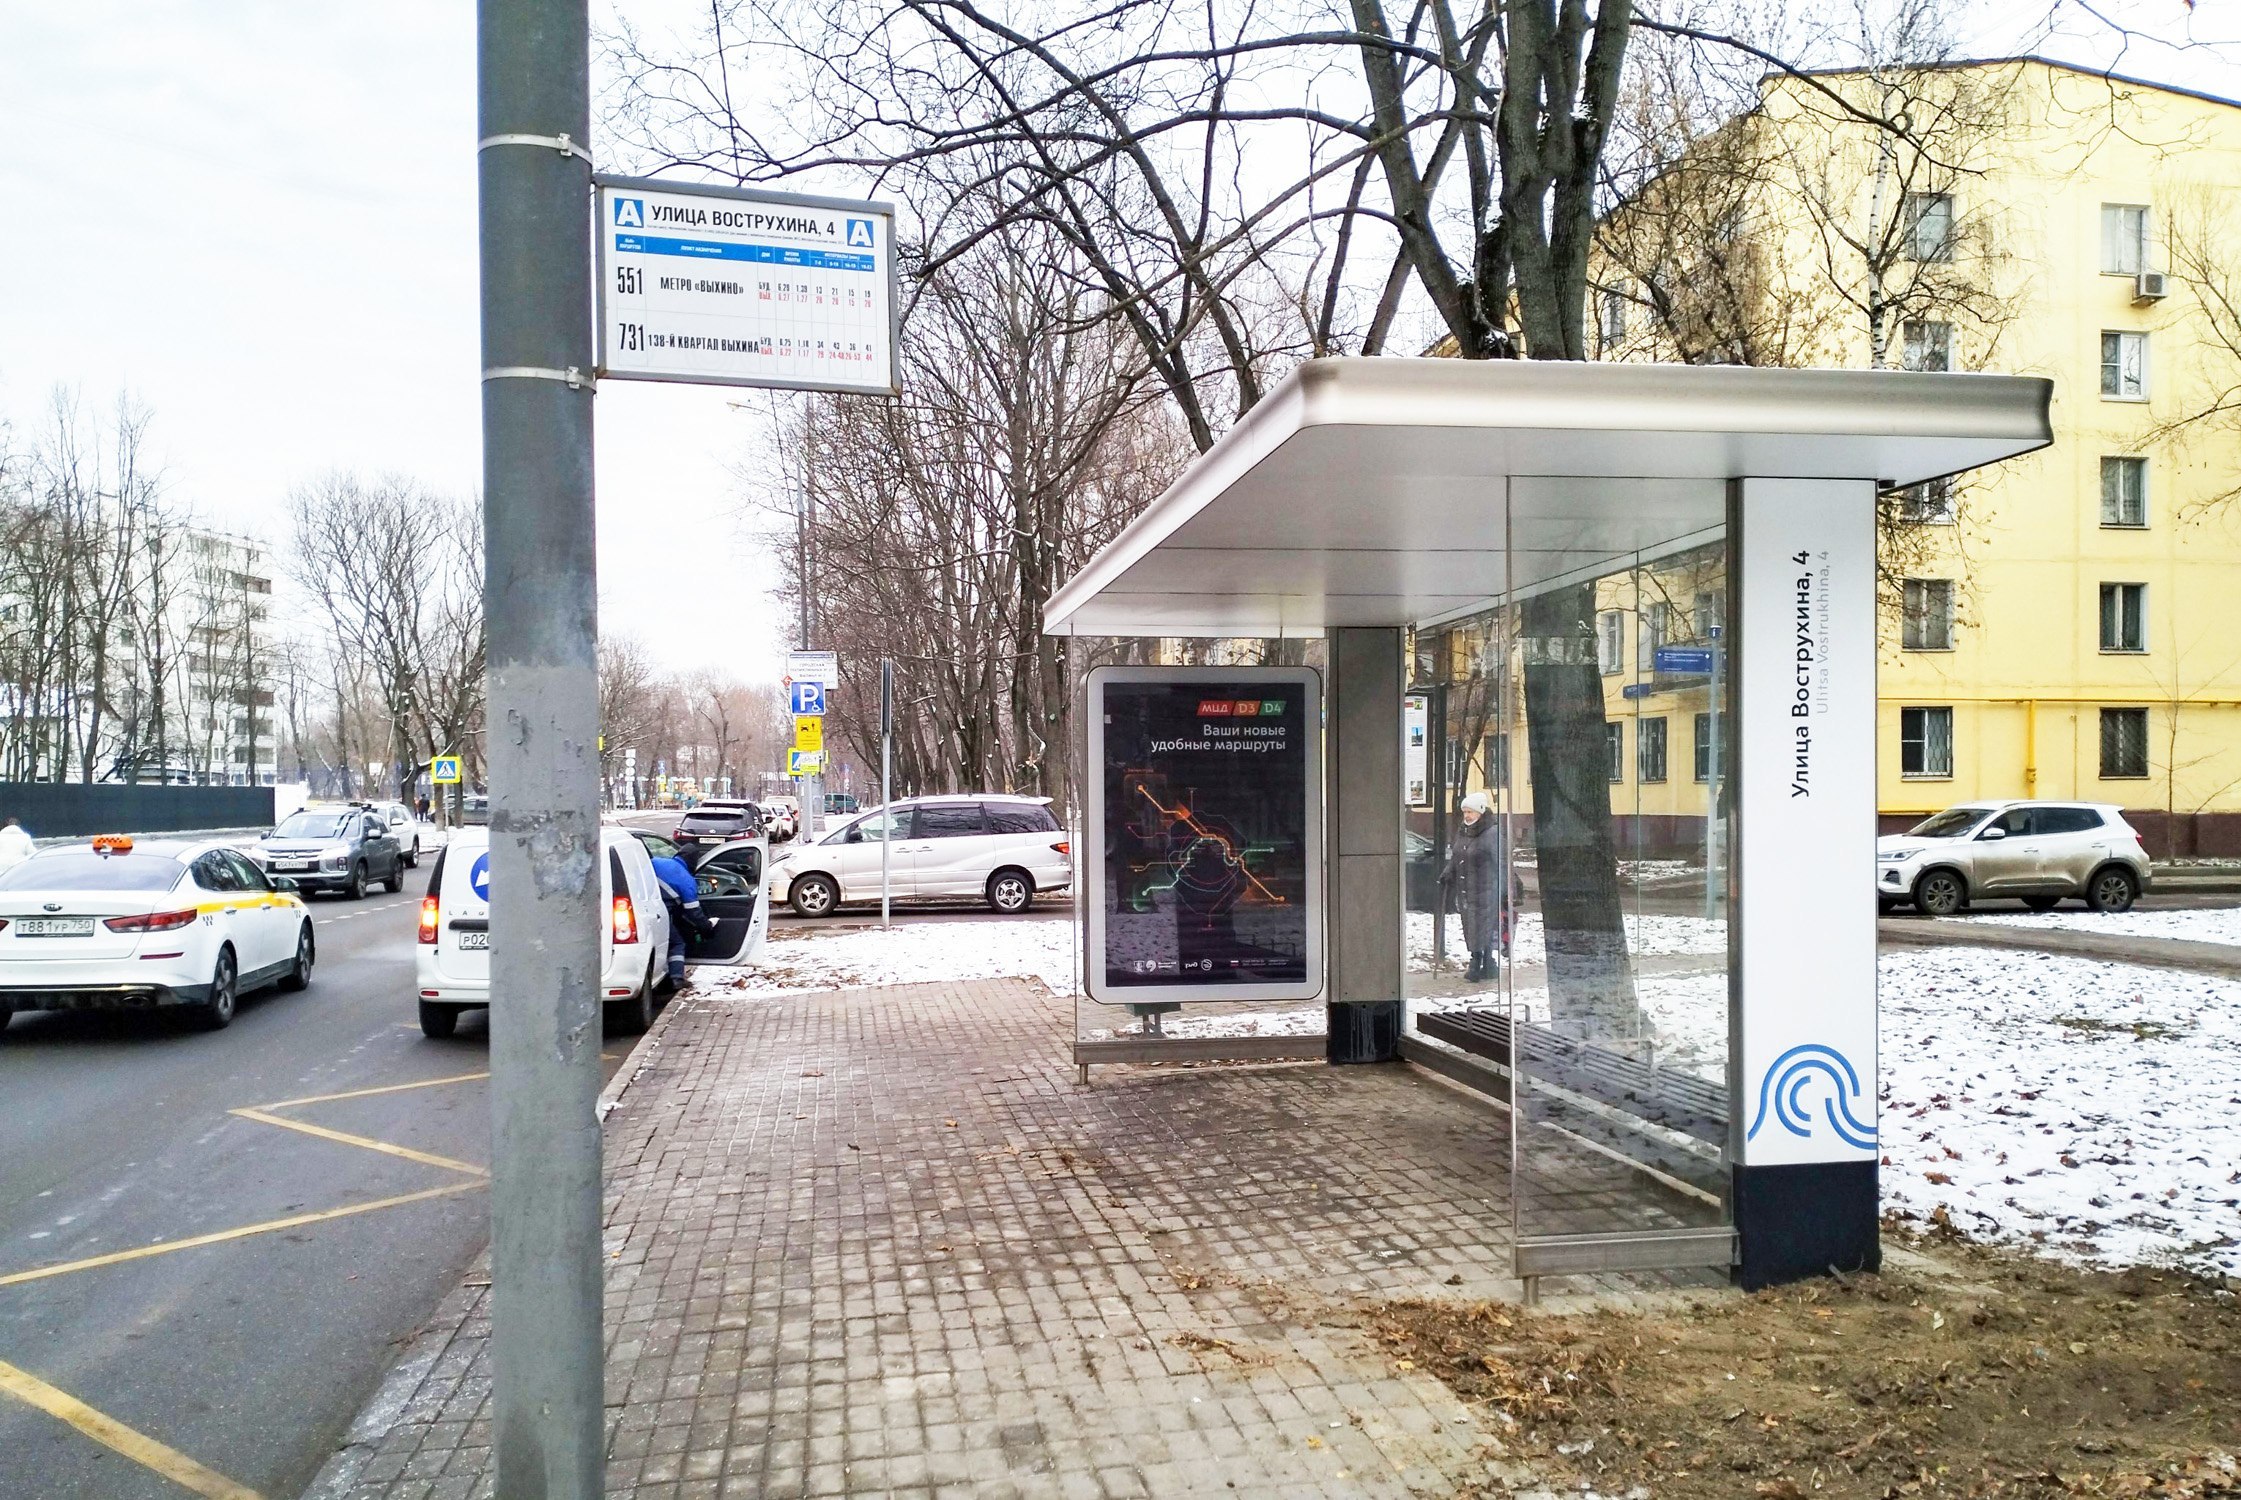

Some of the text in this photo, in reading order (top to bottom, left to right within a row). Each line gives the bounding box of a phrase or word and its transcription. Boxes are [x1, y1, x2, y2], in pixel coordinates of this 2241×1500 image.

[652, 205, 707, 227] УЛИЦА
[713, 211, 822, 237] ВОСТРУХИНА,
[826, 222, 835, 235] 4
[617, 266, 744, 295] 551 МЕТРО «ВЫХИНО»
[619, 323, 759, 354] 731 138-Й КВАРТАЛ ВЫХИНА
[1816, 551, 1830, 714] Ulitsa Vostrukhina, 4
[1791, 550, 1814, 798] Улица Вострухина, 4
[1239, 703, 1256, 713] D3
[1264, 703, 1281, 713] D4
[1151, 738, 1286, 752] удобные маршруты
[1203, 724, 1286, 736] Ваши новые
